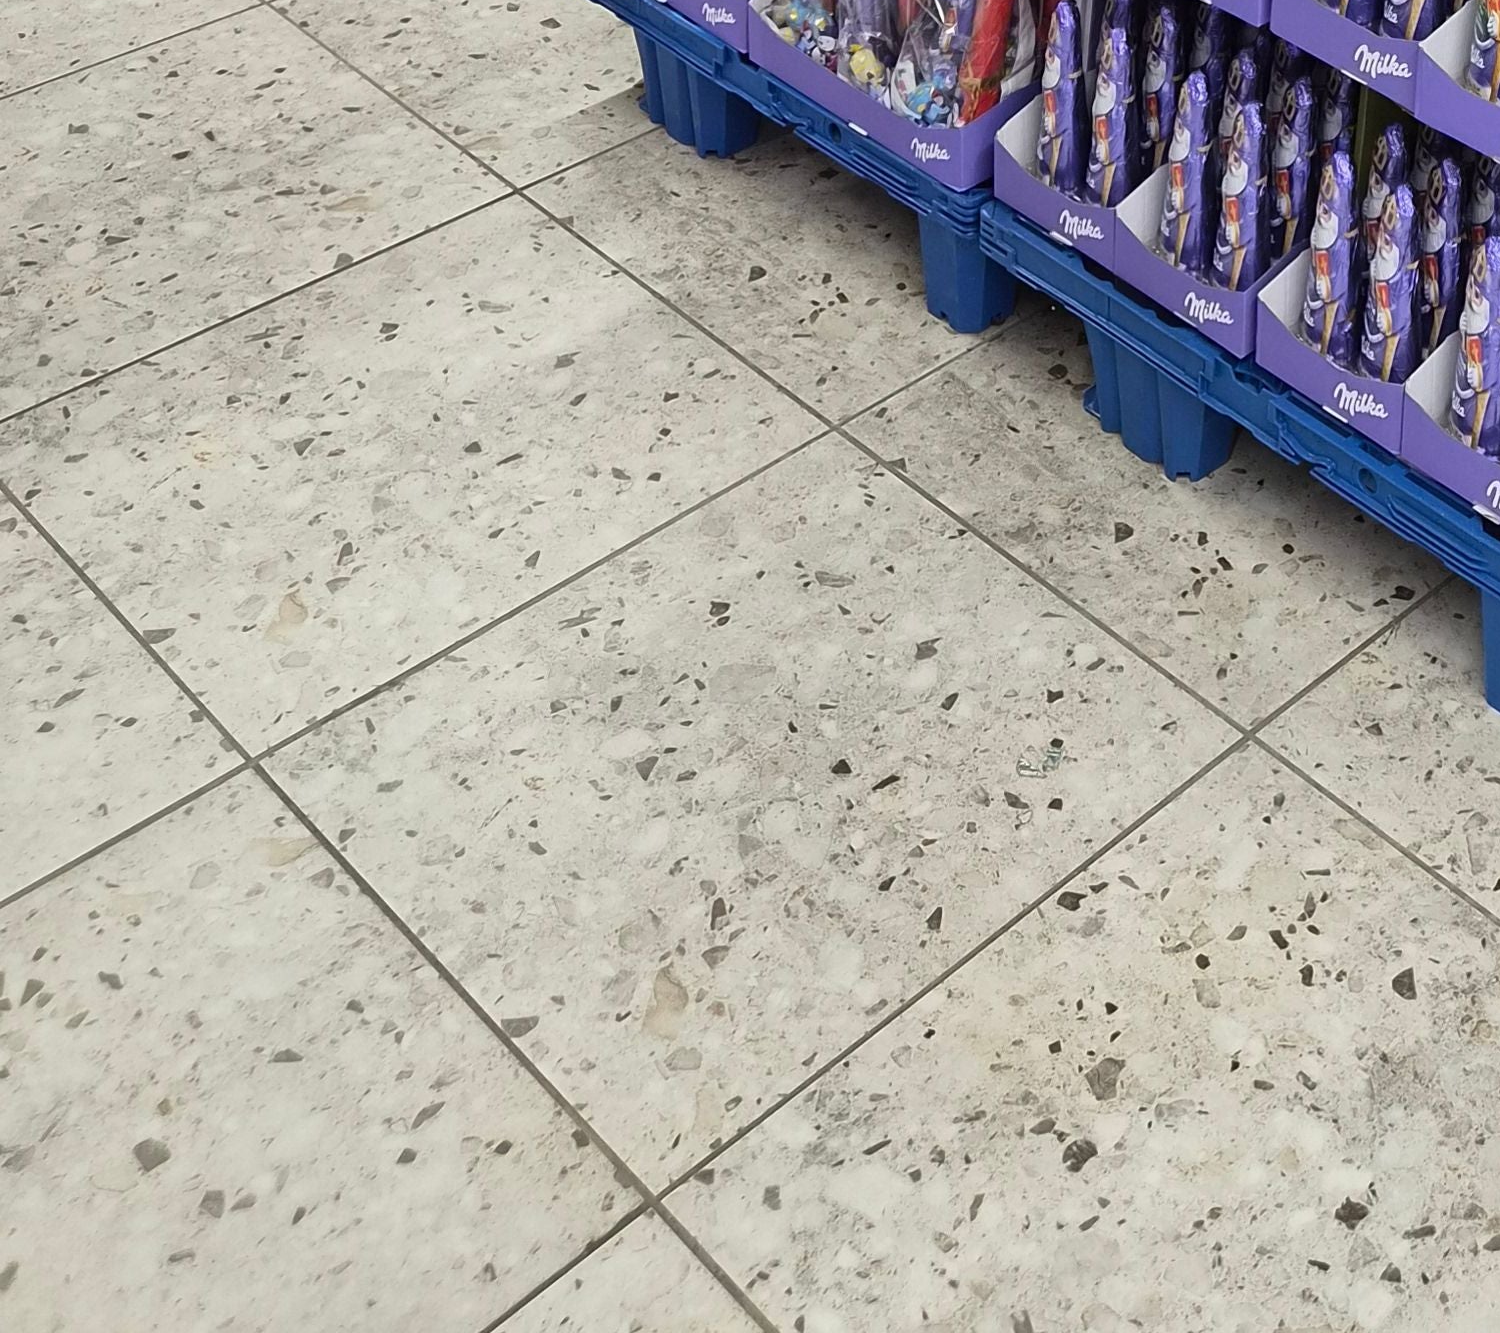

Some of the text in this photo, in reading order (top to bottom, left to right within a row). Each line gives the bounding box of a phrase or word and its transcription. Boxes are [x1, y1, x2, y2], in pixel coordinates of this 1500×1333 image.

[701, 2, 737, 26] Milka
[1355, 44, 1413, 79] Milka
[911, 136, 951, 162] Milka
[1059, 209, 1105, 240] Milka
[1184, 291, 1234, 325] Milka
[1333, 383, 1388, 419] Milka
